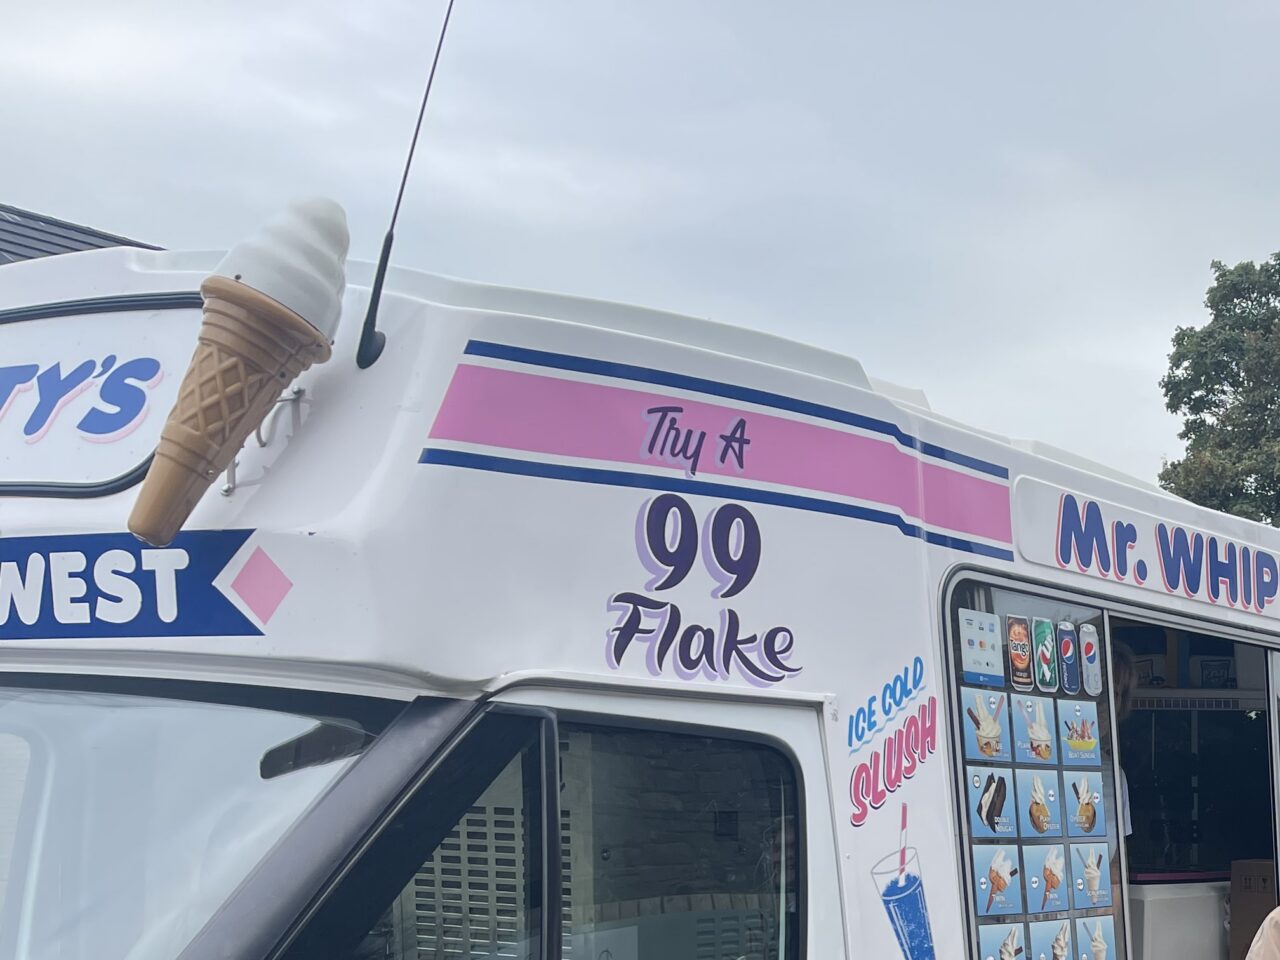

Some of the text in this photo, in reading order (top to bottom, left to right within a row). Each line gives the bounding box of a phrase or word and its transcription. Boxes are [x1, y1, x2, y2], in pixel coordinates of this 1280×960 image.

[642, 406, 751, 477] Try A
[636, 493, 762, 599] 99
[1056, 493, 1148, 586] Mr.
[606, 592, 803, 687] Flake
[1010, 640, 1030, 657] Tango
[848, 656, 924, 747] ICE COLD
[850, 696, 937, 827] SLUSH
